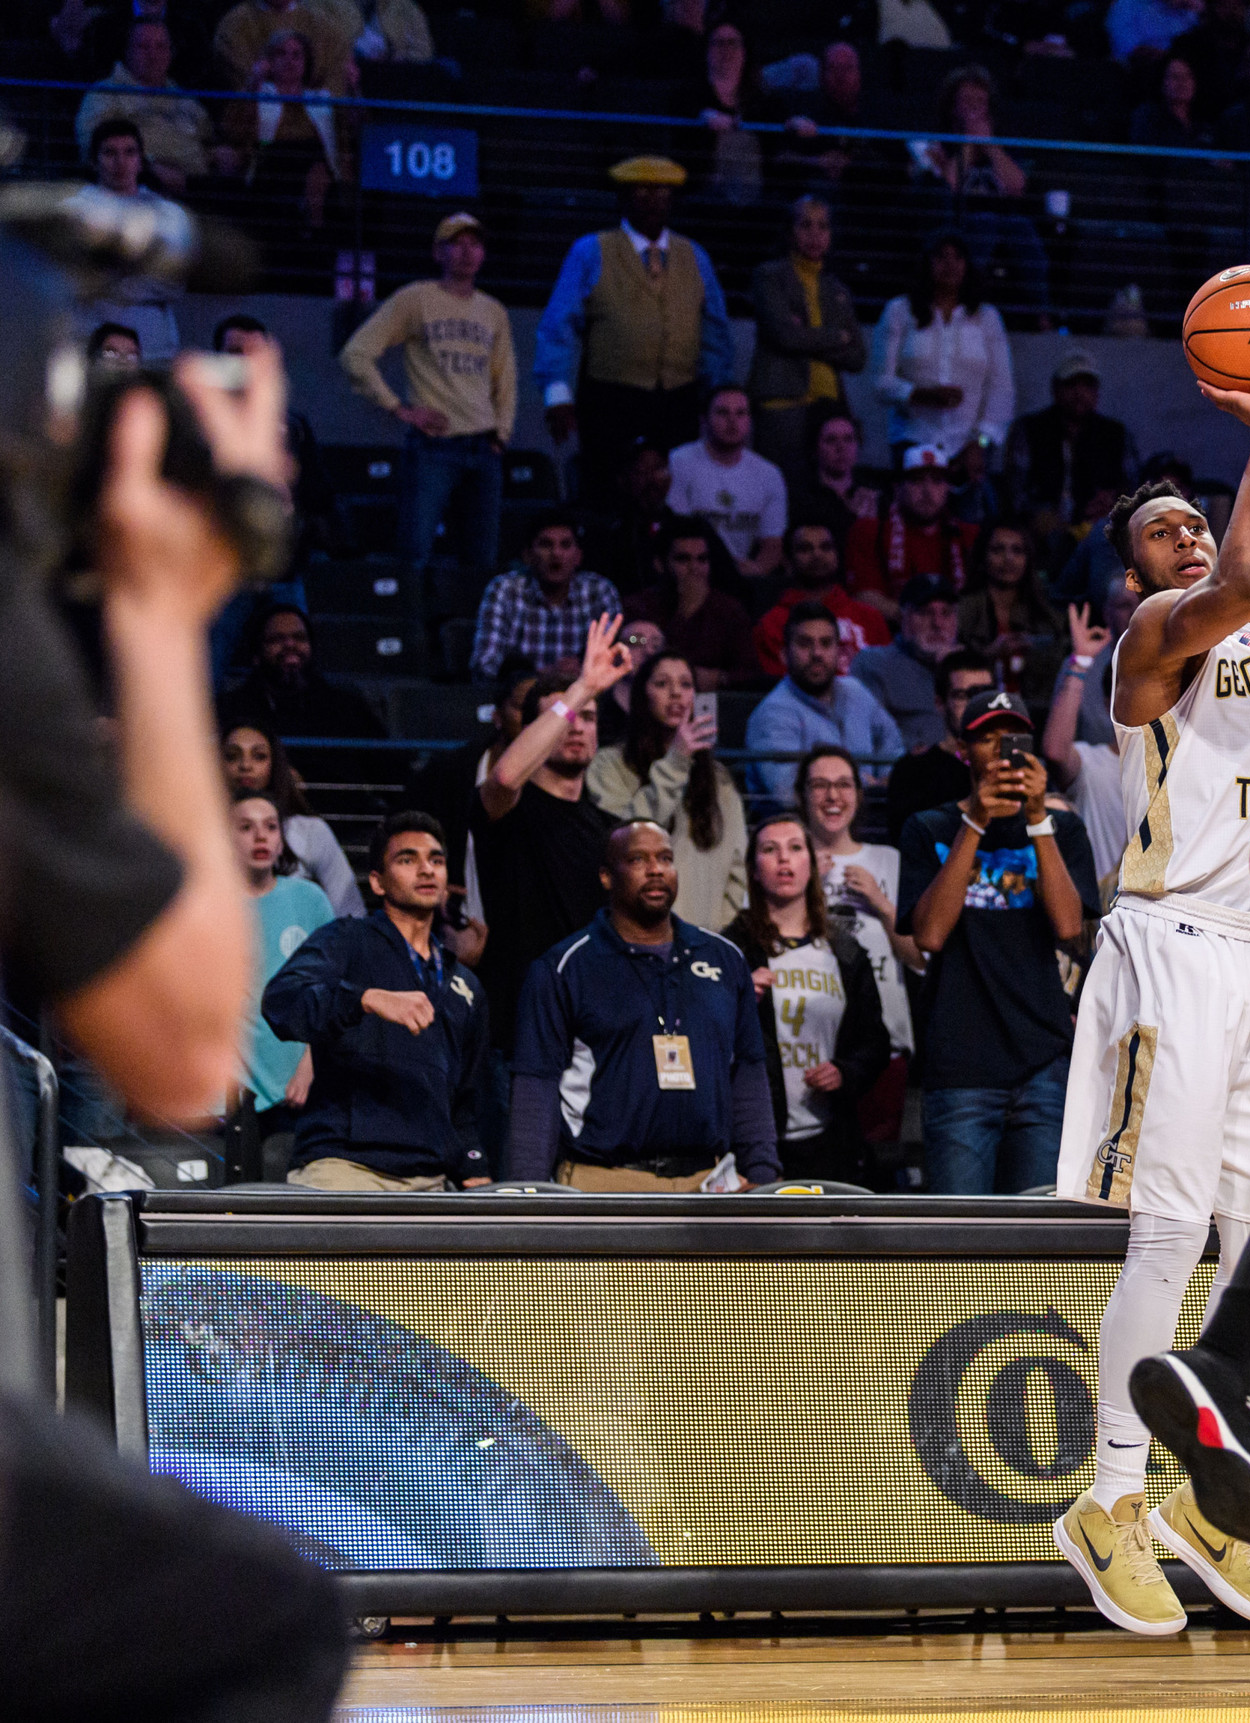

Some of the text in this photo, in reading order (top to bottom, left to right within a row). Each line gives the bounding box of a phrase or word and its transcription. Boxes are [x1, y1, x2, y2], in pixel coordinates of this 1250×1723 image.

[385, 140, 457, 181] 108
[774, 968, 842, 1000] ORGIA
[781, 996, 807, 1038] 4
[778, 1042, 820, 1068] ECH
[1097, 1140, 1132, 1173] GT
